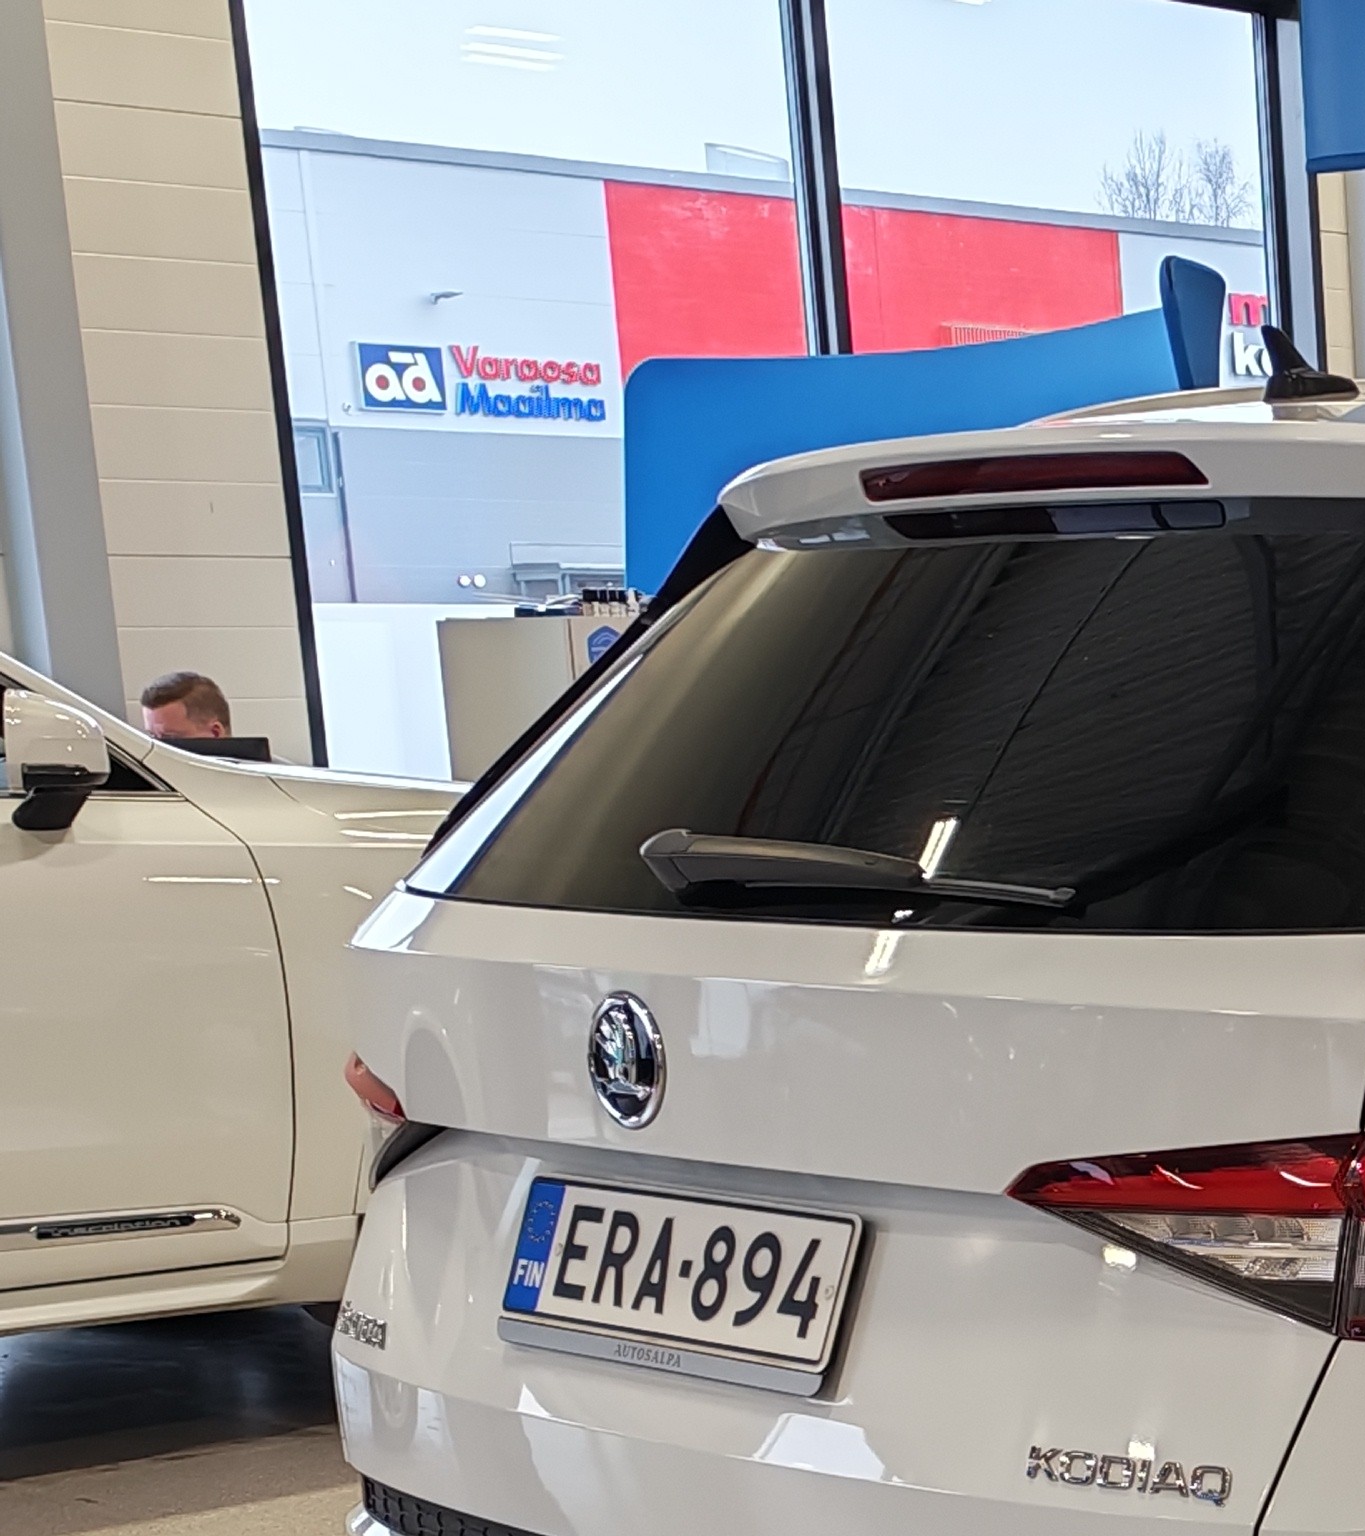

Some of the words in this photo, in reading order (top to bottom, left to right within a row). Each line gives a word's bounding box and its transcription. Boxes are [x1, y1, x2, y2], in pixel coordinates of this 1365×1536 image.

[449, 345, 601, 385] Varaosa
[455, 382, 606, 421] Maailma
[512, 1258, 546, 1289] FIN
[552, 1204, 822, 1340] ERA-894
[613, 1343, 682, 1369] AUTOSALPA
[1026, 1445, 1233, 1508] KODIAQ
